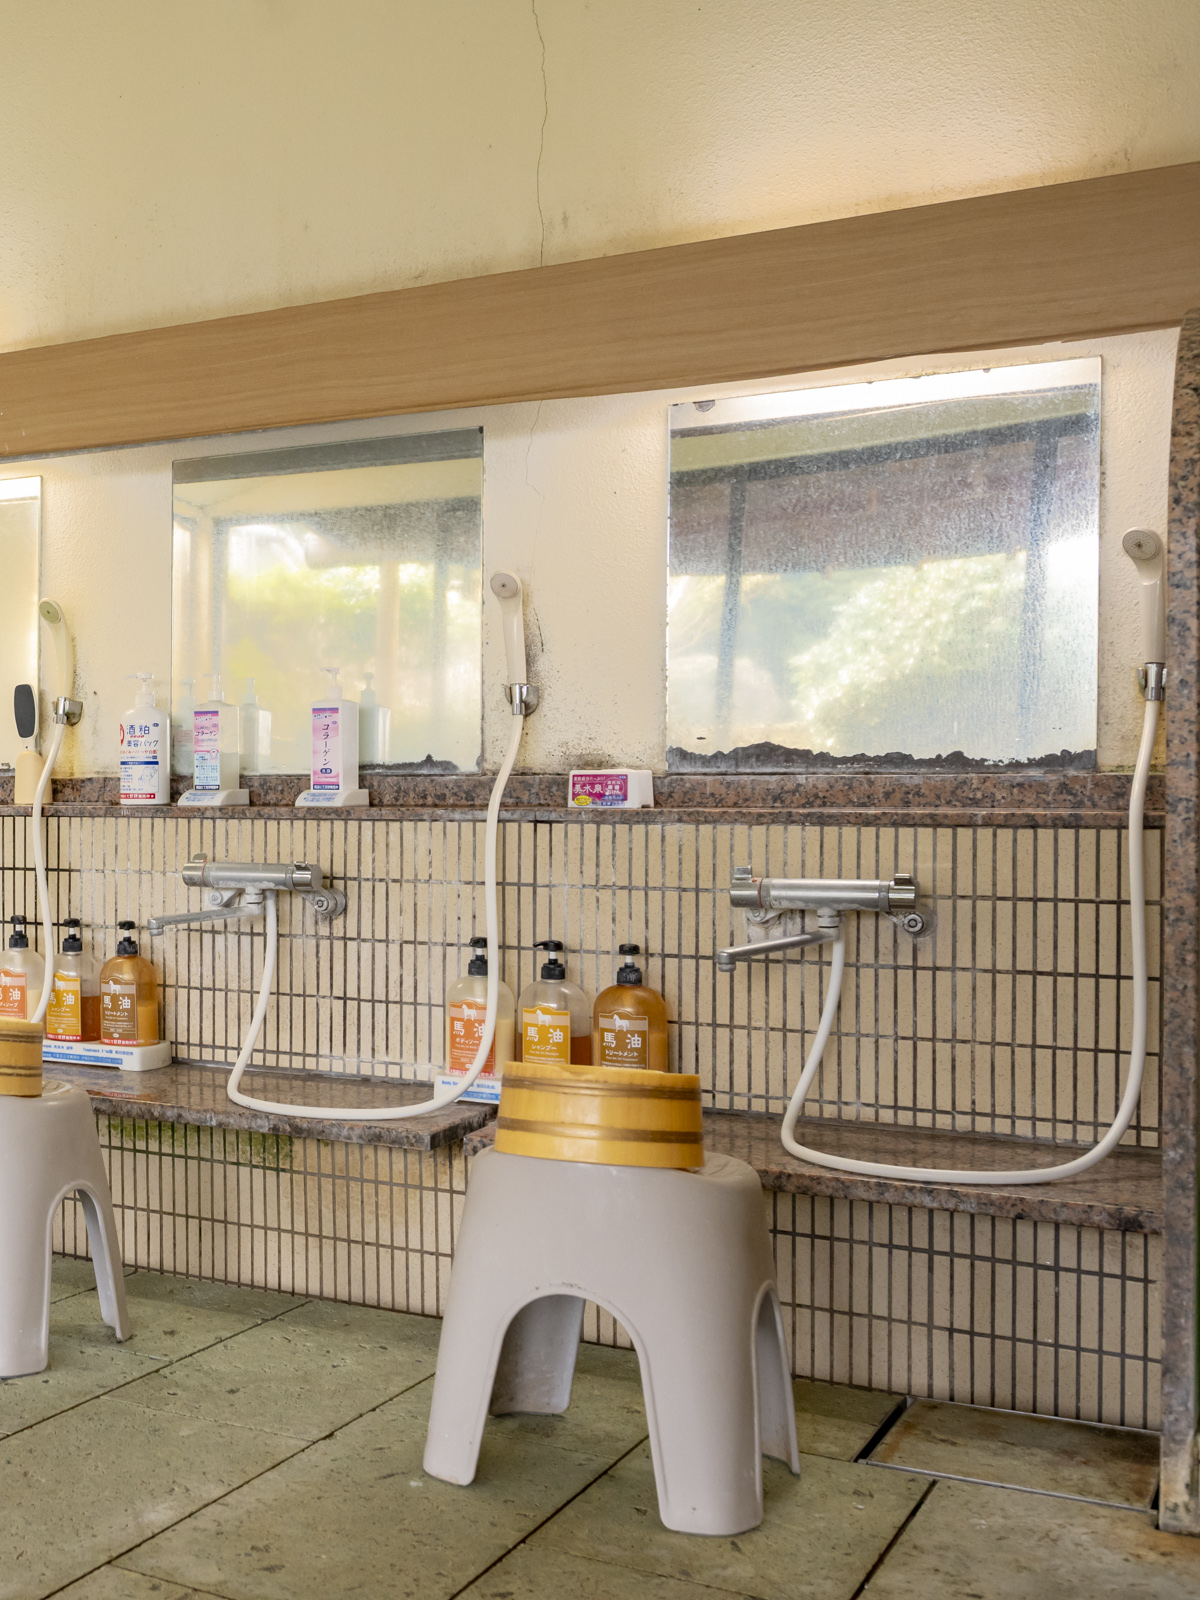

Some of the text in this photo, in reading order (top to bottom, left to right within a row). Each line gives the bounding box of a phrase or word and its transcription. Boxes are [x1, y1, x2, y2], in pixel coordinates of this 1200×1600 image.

[322, 724, 331, 766] コラーゲン
[103, 995, 131, 1009] 馬油
[455, 1037, 483, 1045] ボディソー
[526, 1026, 564, 1044] 馬油
[603, 1031, 642, 1049] 馬油
[605, 1049, 639, 1057] トリートメント
